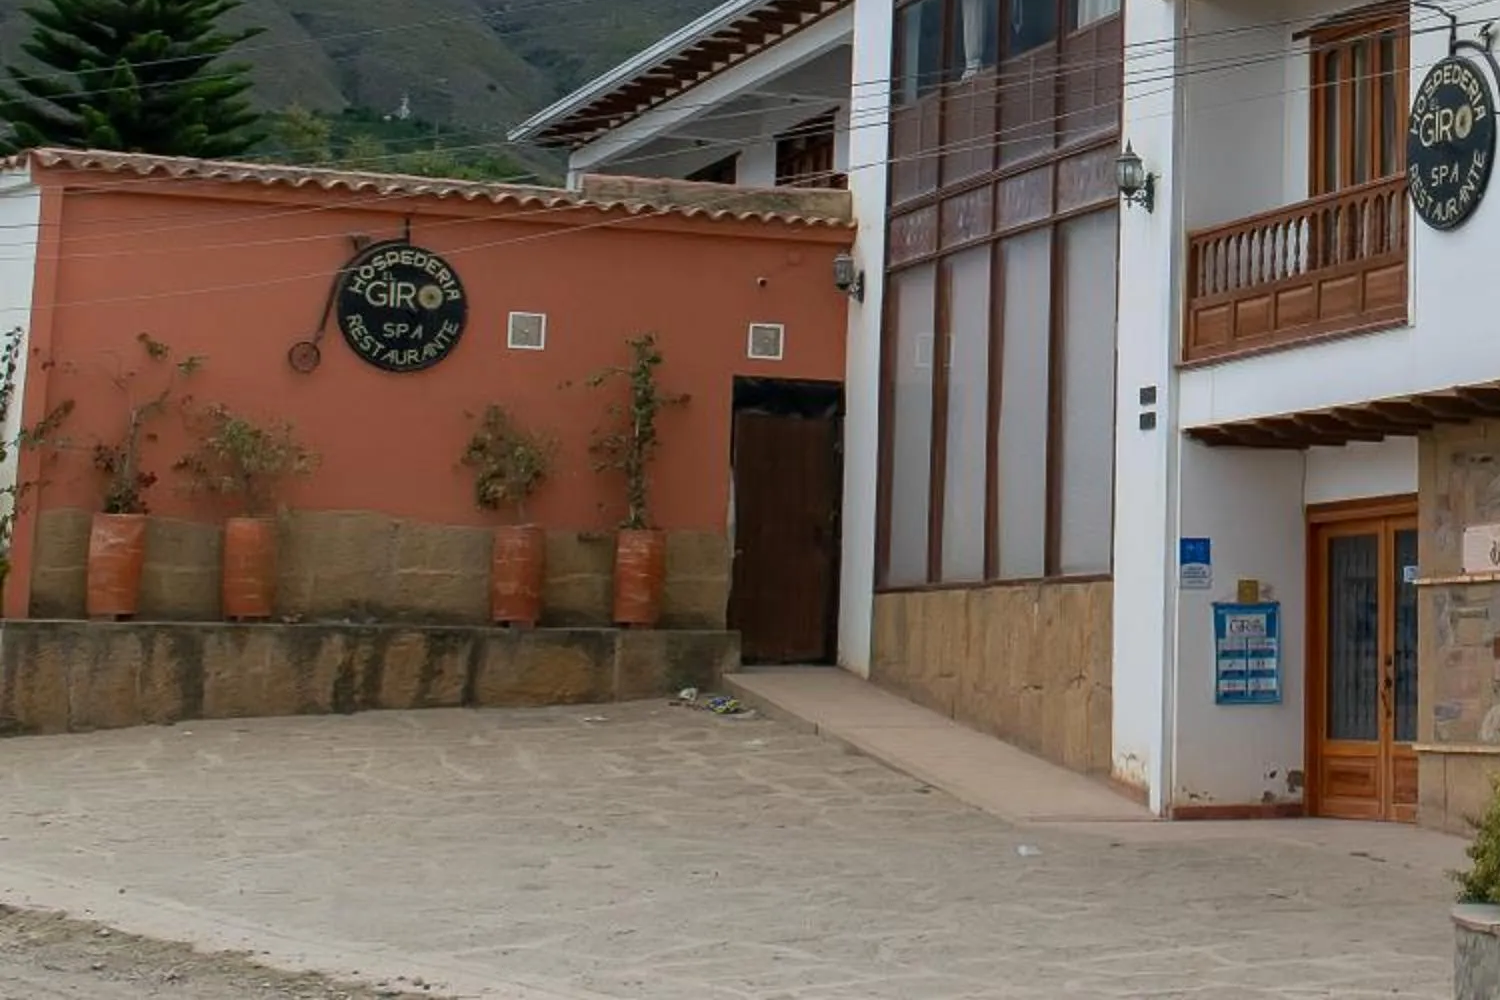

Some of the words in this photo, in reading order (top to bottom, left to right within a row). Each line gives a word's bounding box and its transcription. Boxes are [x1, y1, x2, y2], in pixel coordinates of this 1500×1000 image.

[1410, 63, 1486, 135] HOSPEDERIA
[1419, 104, 1473, 147] GIRO
[1410, 150, 1486, 221] RESTAURANTE
[1431, 162, 1459, 187] SPA
[347, 250, 461, 301] HOSPEDERIA
[365, 281, 443, 313] GIRO
[346, 313, 460, 365] RESTAURANTE
[383, 322, 424, 339] SPA
